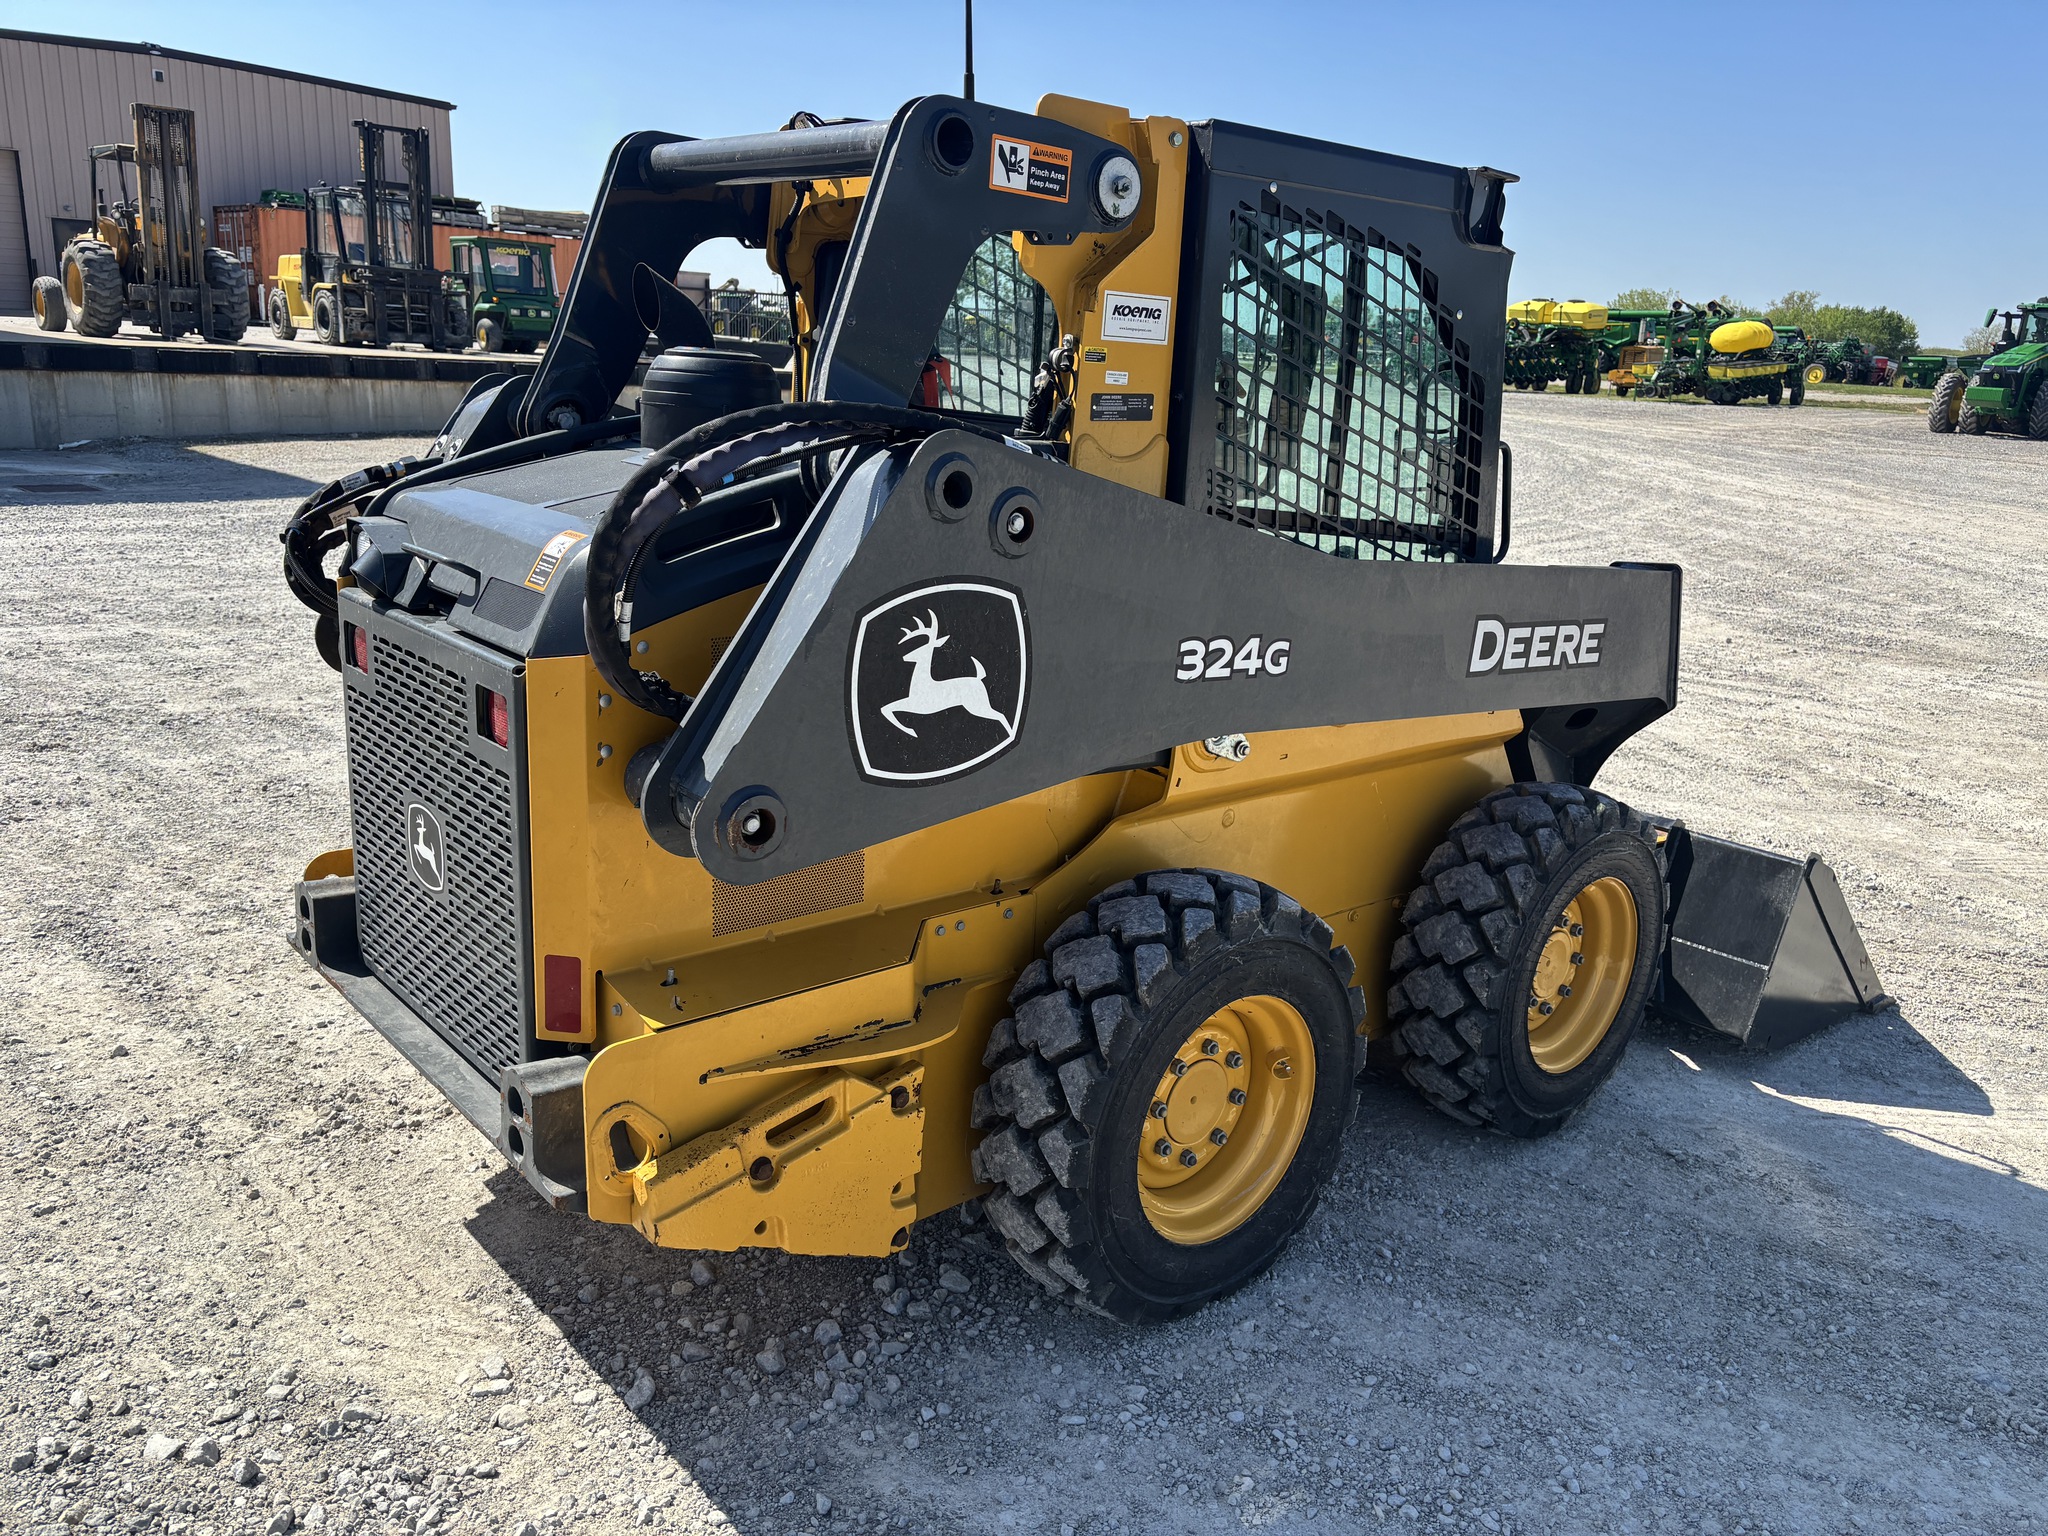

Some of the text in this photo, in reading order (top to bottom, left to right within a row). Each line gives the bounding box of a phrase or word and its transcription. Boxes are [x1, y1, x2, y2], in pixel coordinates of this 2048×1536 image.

[1039, 149, 1068, 162] WARNING
[1030, 166, 1066, 181] Pinch Area
[1029, 178, 1060, 191] Keep Away
[1469, 619, 1605, 673] DEERE
[1177, 637, 1290, 680] 324G
